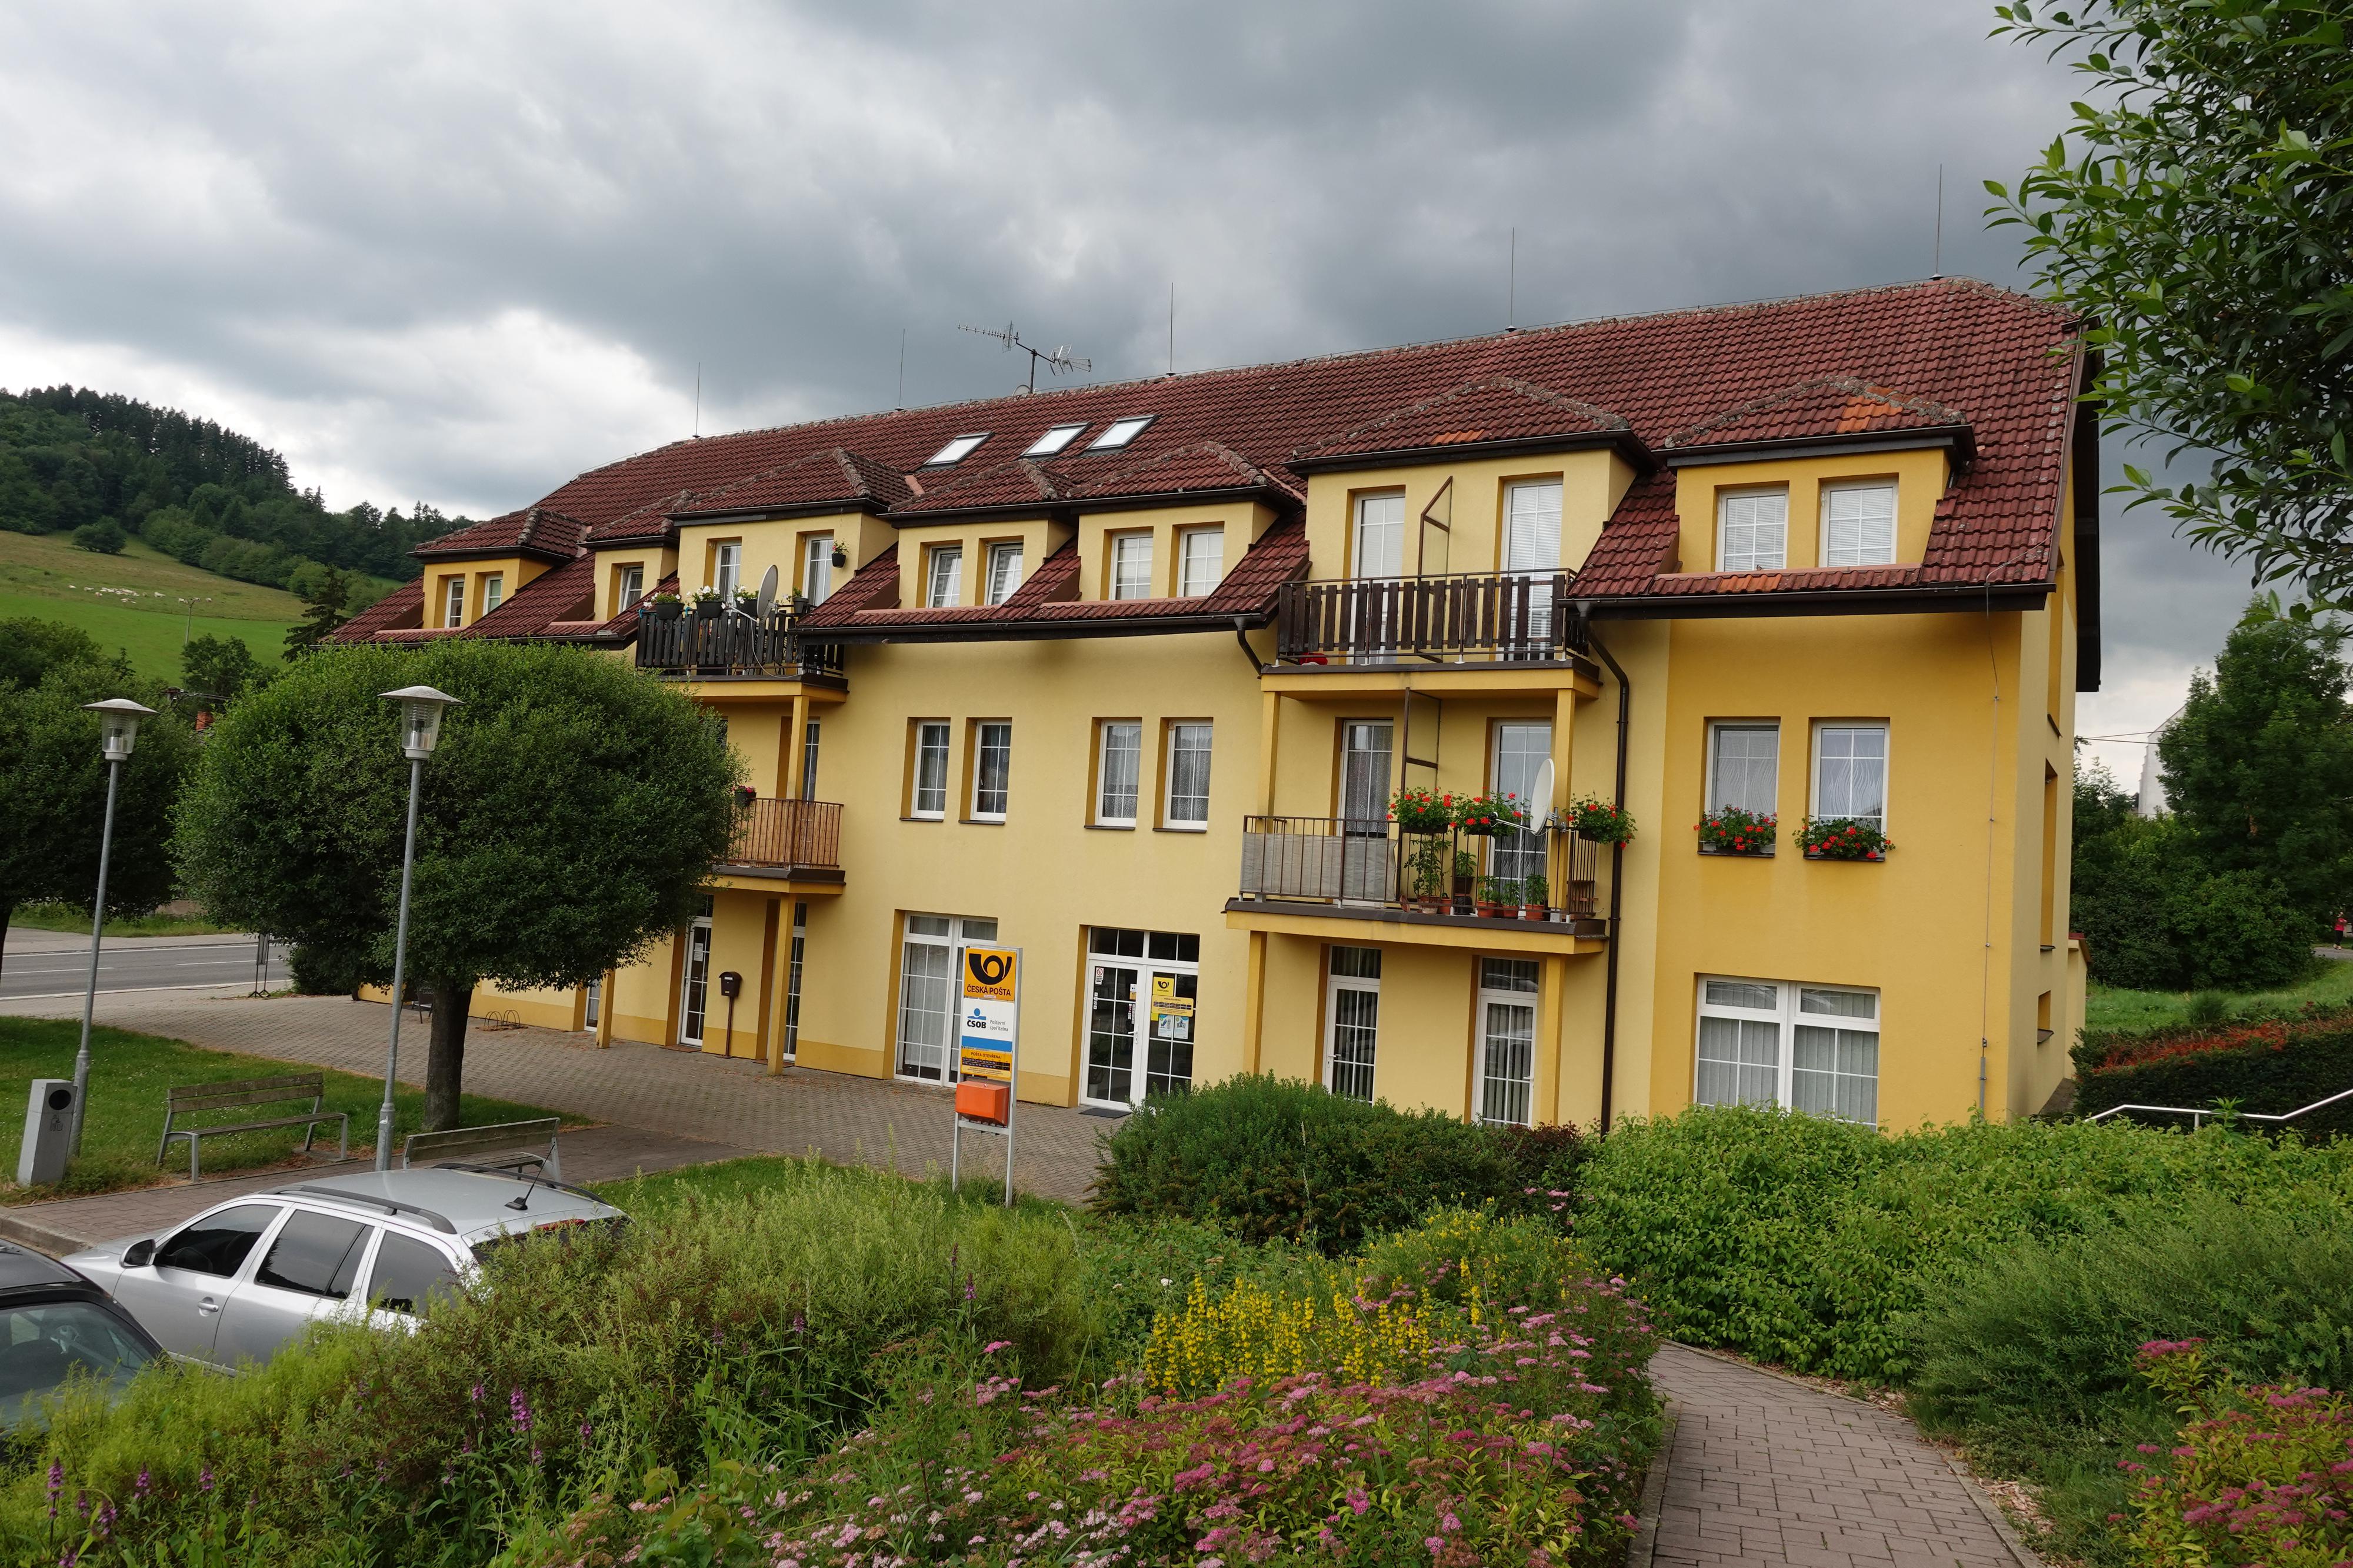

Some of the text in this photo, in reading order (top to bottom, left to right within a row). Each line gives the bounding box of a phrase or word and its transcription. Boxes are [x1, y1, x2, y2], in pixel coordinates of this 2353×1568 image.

[966, 984, 1011, 996] ČESKÁ POŠTA
[966, 1019, 986, 1029] ČSOB
